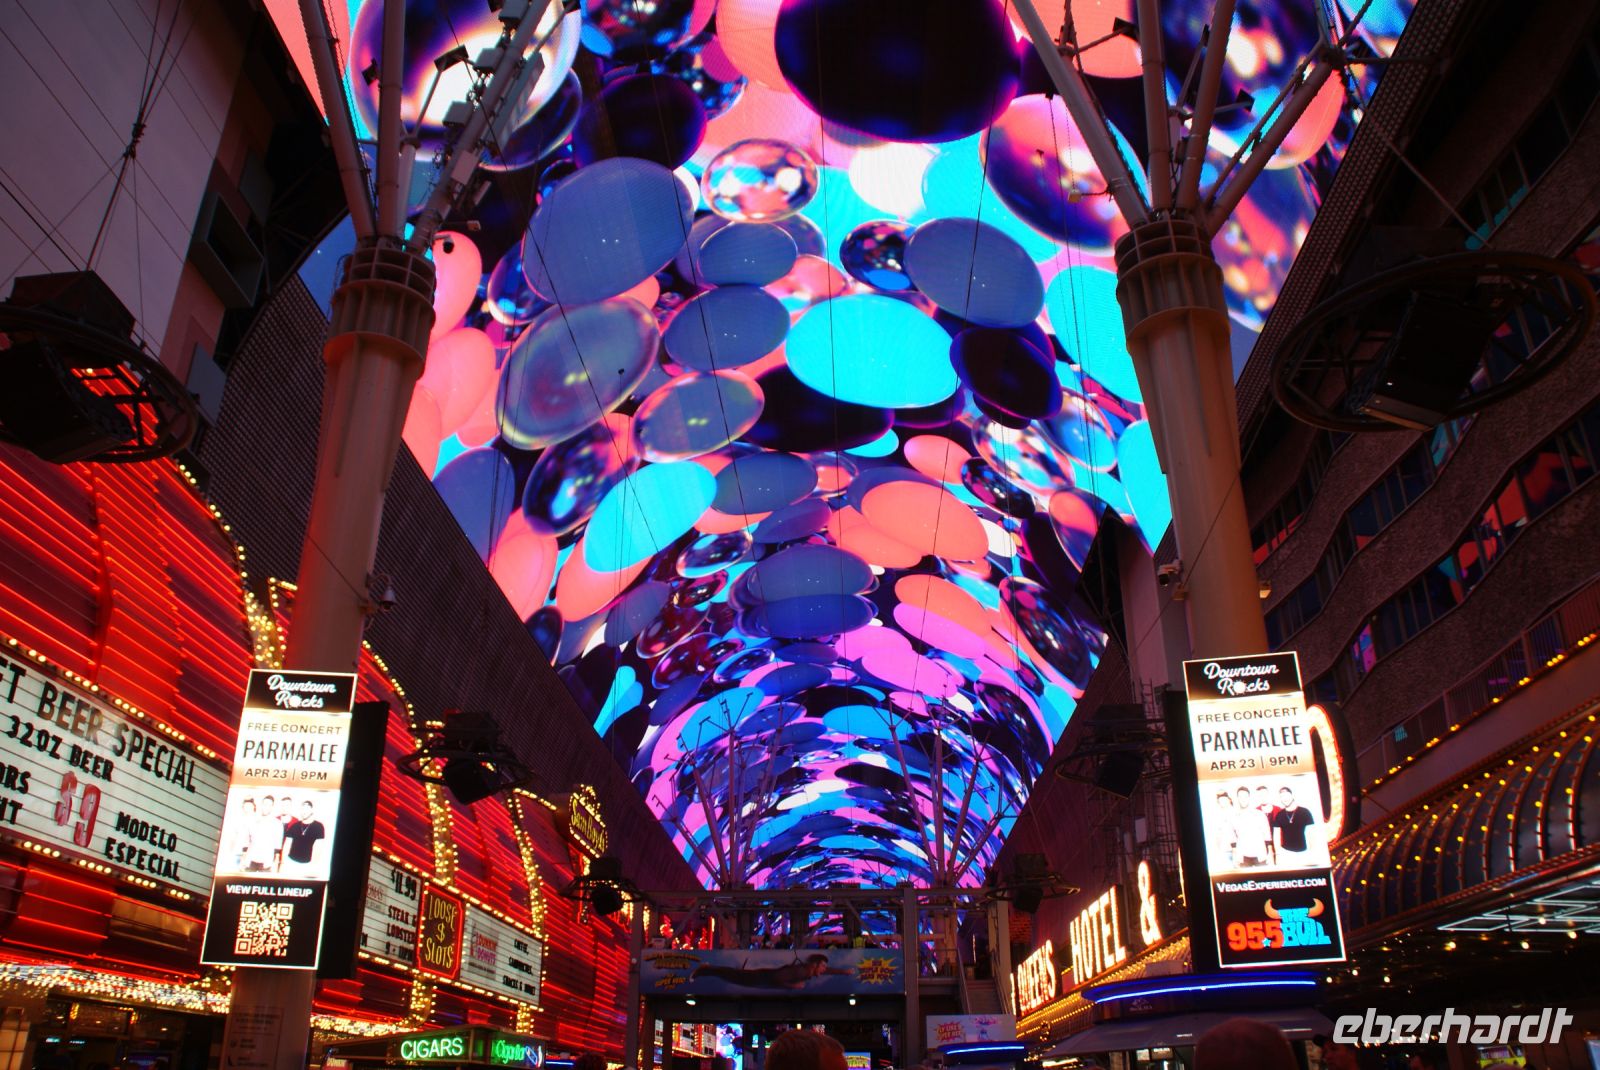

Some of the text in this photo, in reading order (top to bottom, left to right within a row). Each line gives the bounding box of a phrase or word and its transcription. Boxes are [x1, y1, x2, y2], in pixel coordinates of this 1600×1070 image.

[1203, 661, 1280, 679] Downtown
[266, 674, 337, 694] Downtown
[1198, 706, 1299, 724] FREE CONCERT
[37, 681, 104, 746] BEER
[112, 722, 196, 794] SPECIAL
[247, 721, 342, 736] FREE CONCERT
[1200, 725, 1302, 752] PARMALEE
[69, 744, 114, 783] BEER
[242, 740, 338, 764] PARMALEE
[1210, 754, 1299, 770] APR 23 9PM
[245, 768, 328, 782] APR 23 9PM
[115, 812, 178, 852] MODELO
[105, 838, 180, 882] ESPECIAL
[226, 884, 313, 899] VIEW FULL LINEUP
[1137, 860, 1163, 946] &
[428, 894, 457, 932] LOOSE
[1279, 907, 1309, 924] THE
[435, 921, 446, 943] $
[1069, 885, 1126, 985] HOTEL
[1280, 921, 1332, 948] BULL
[425, 936, 454, 969] SLOTS
[400, 1037, 463, 1060] CIGARS
